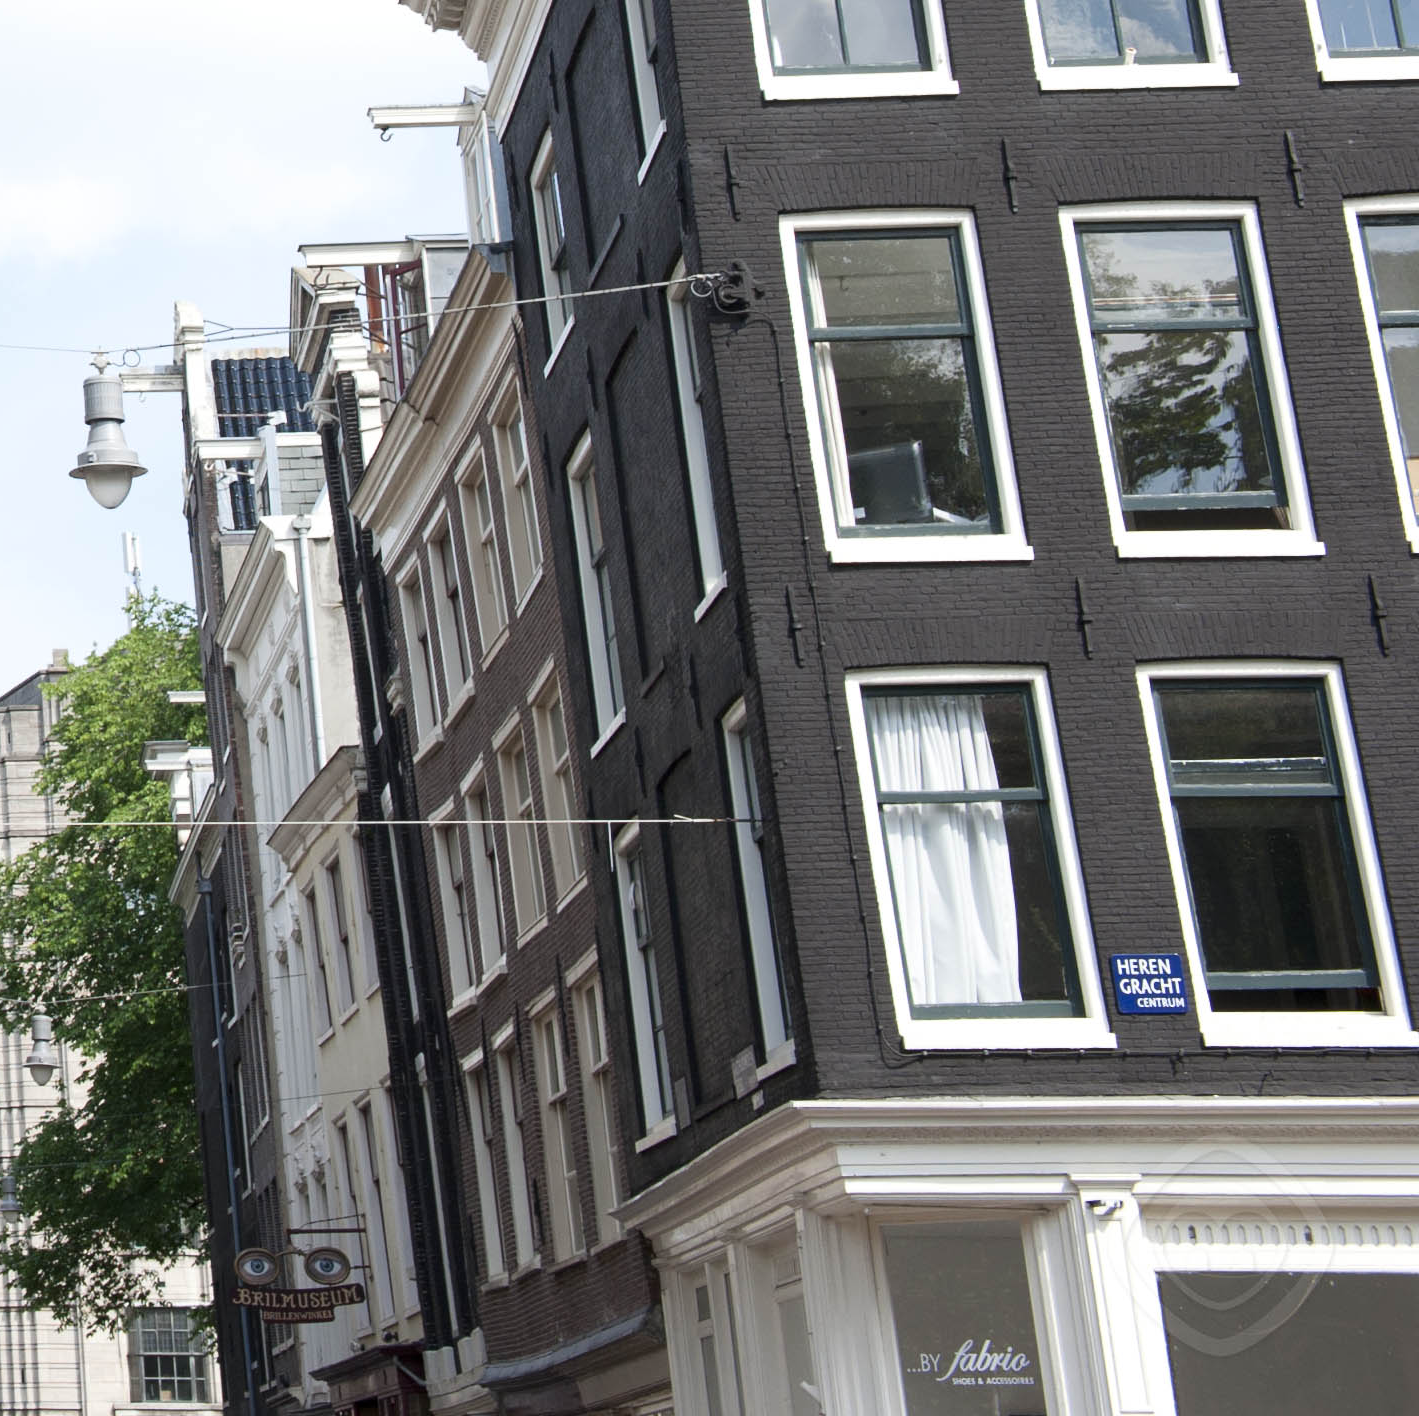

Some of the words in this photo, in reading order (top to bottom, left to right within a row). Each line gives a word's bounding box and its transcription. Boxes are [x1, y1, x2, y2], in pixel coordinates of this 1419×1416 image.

[1116, 958, 1172, 976] HEREN
[1119, 977, 1182, 995] GRACHT
[1136, 997, 1185, 1008] CENTRUM
[232, 1285, 362, 1309] BRILMUSEUM
[263, 1309, 333, 1321] BRILLENWINKEL
[935, 1339, 1031, 1382] fabrio
